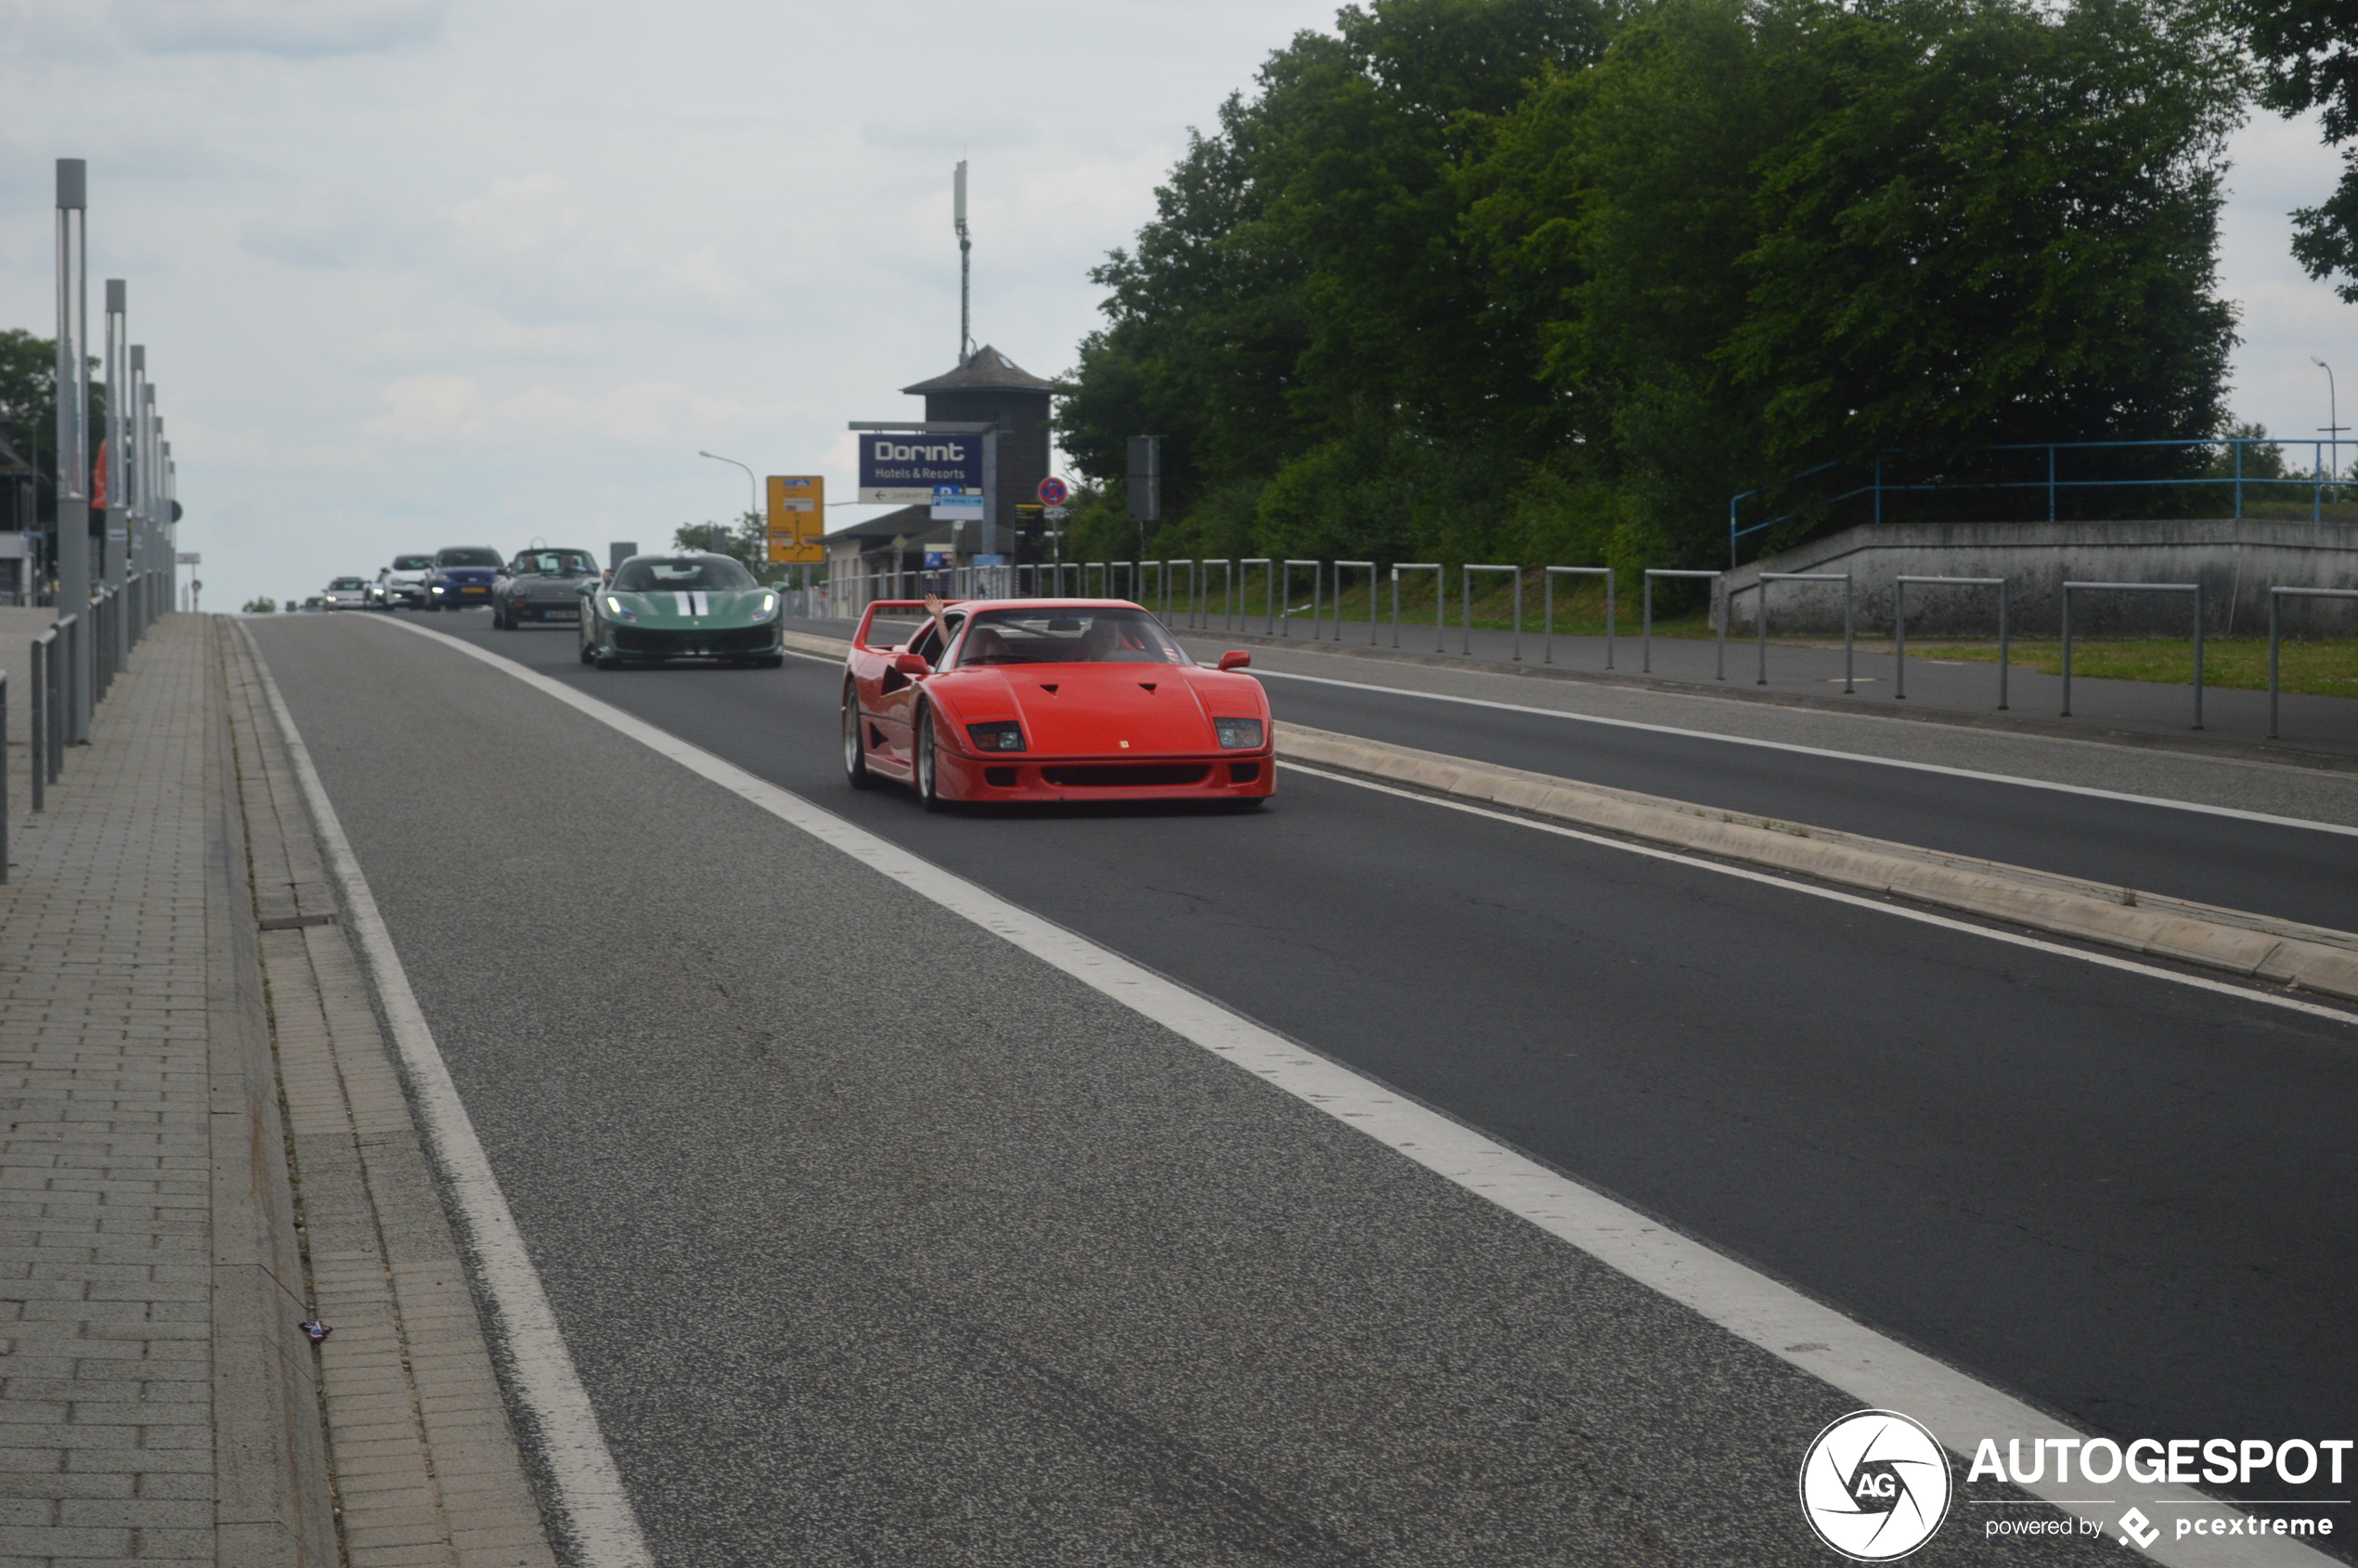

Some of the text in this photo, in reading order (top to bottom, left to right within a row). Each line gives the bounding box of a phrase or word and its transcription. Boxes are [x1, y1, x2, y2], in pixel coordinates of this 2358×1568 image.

[875, 441, 965, 461] Dorint
[875, 468, 965, 479] Hotels & Resorts
[933, 497, 940, 506] P
